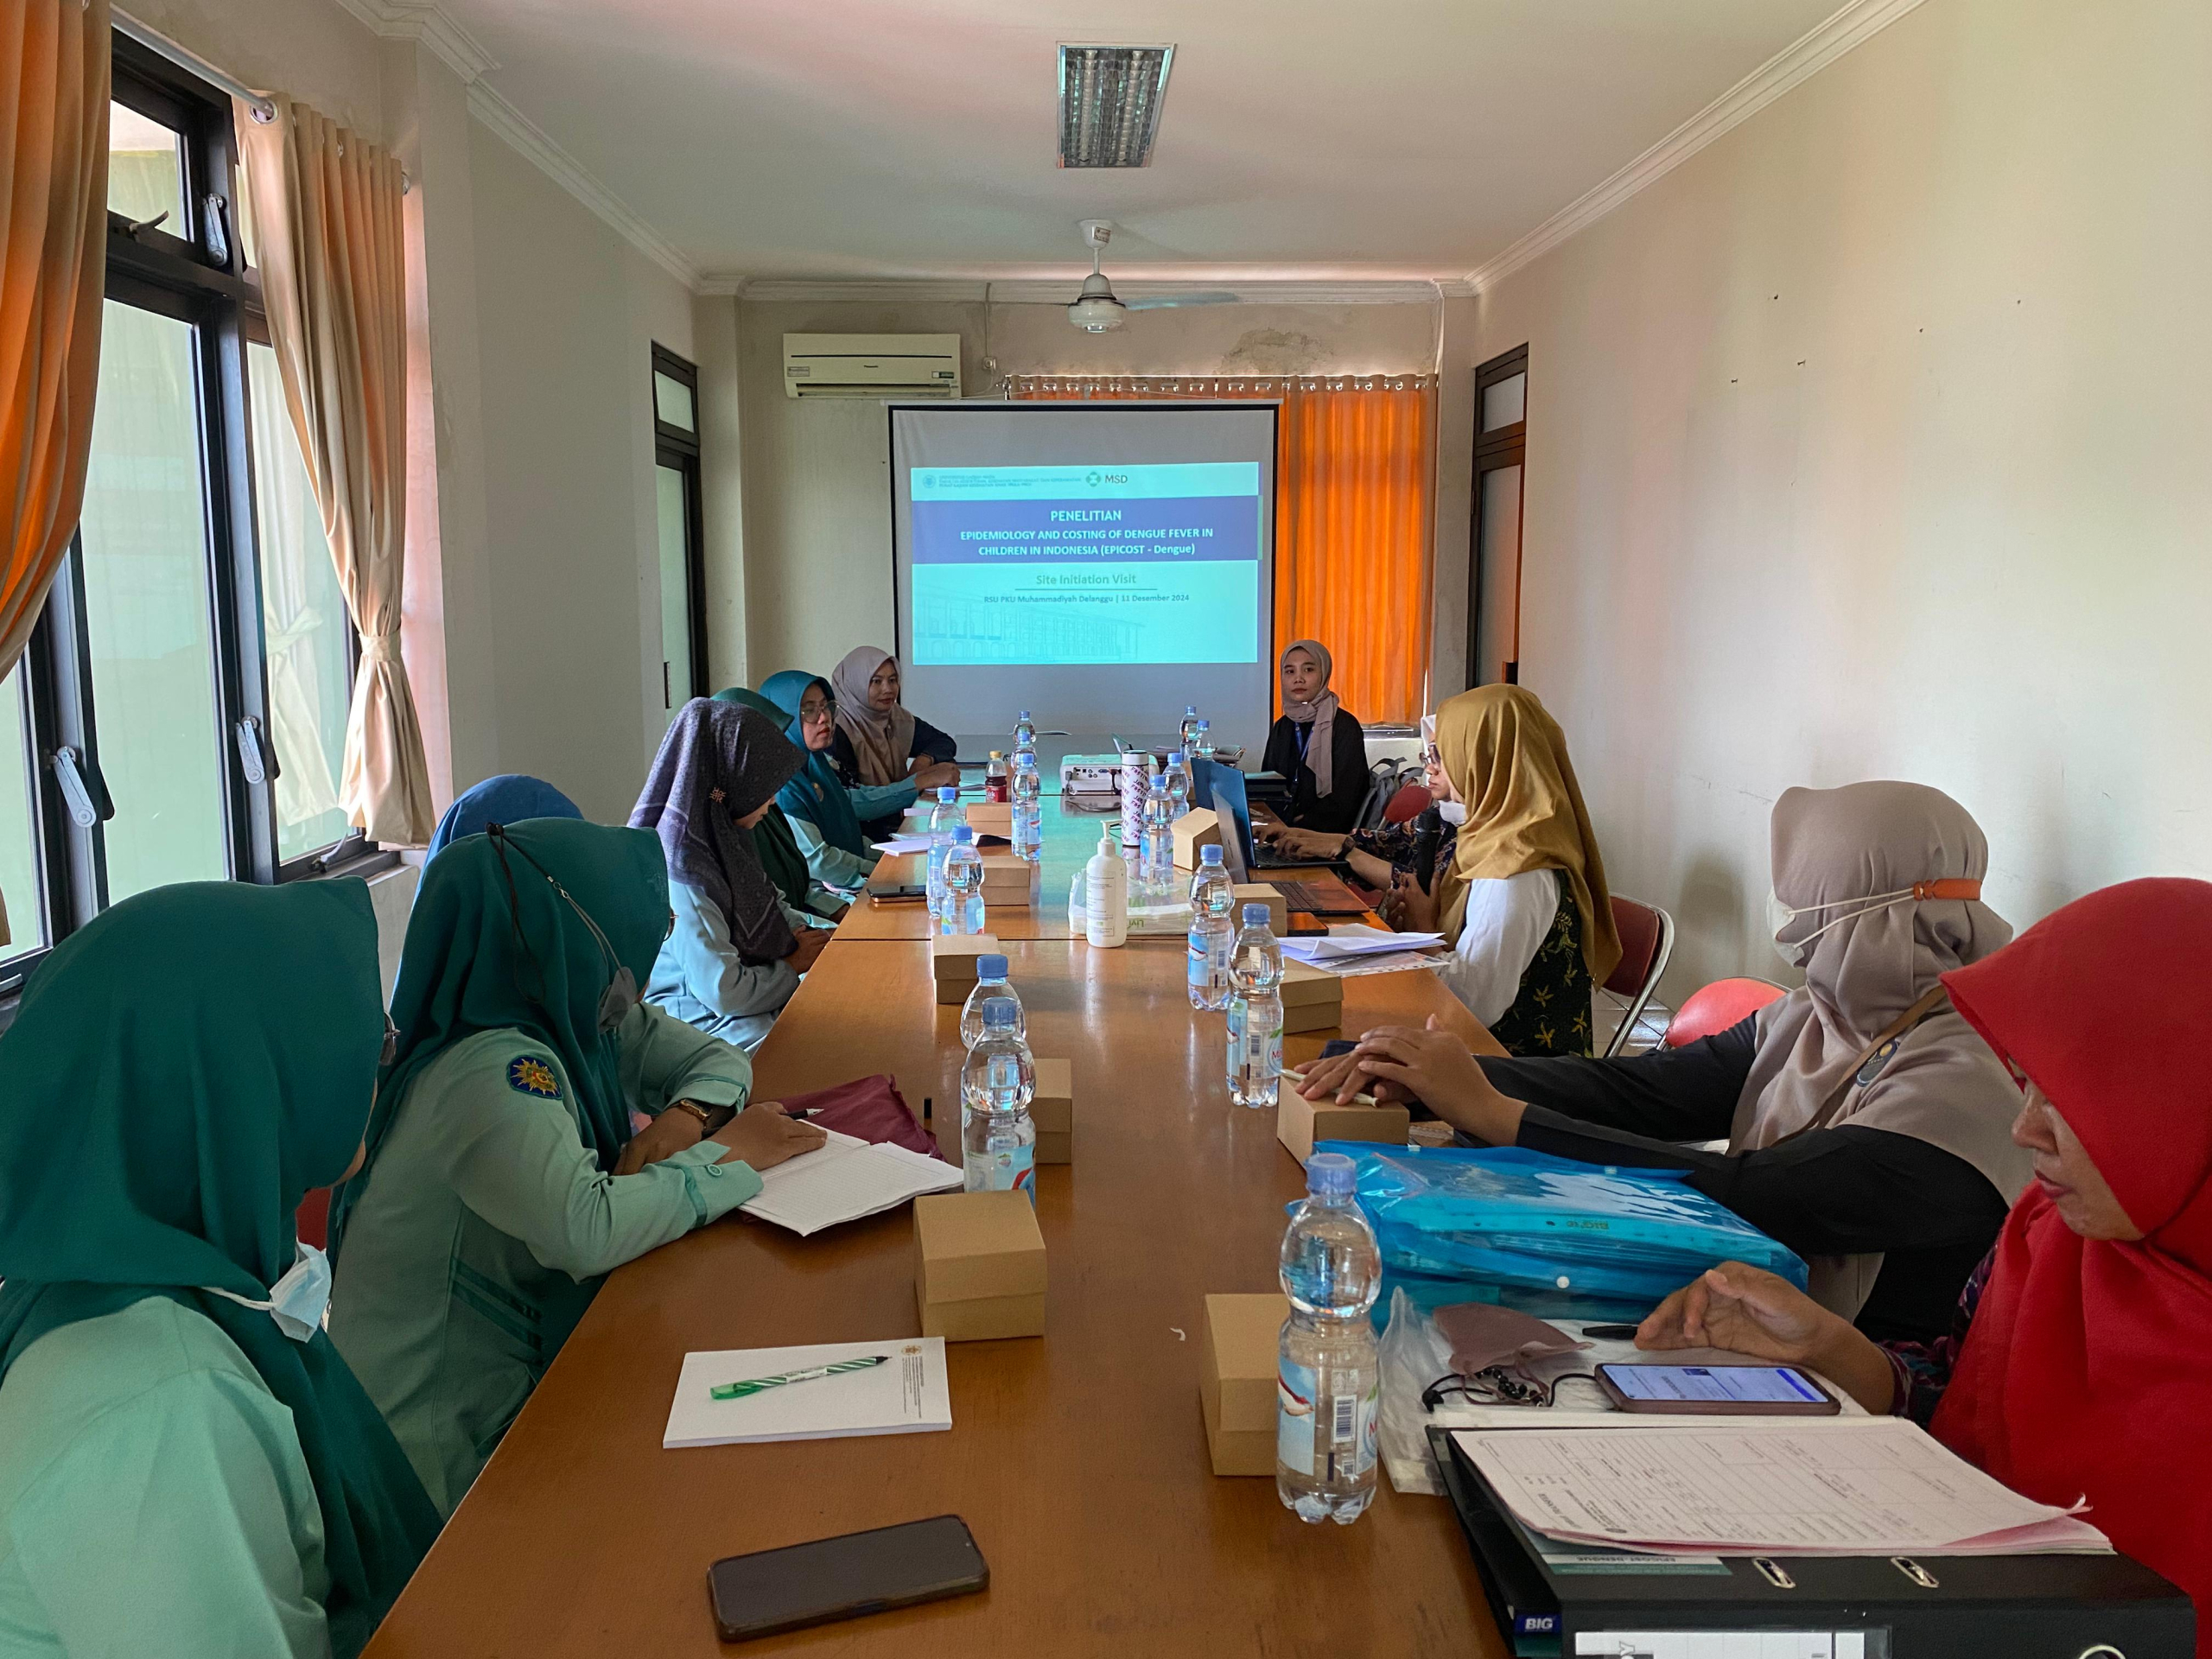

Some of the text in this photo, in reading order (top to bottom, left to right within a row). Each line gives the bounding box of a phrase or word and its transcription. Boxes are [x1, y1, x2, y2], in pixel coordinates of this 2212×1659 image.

[1104, 474, 1128, 484] MSD
[1050, 510, 1122, 522] PENELITIAN
[960, 528, 1214, 541] EPIDEMIOLOGY AND COSTING OF DENGUE FEVER IN
[978, 546, 1027, 556] CHILDREN
[1029, 546, 1041, 555] IN
[1043, 545, 1098, 556] INDONESIA
[1100, 544, 1145, 556] (EPICOST
[1154, 543, 1196, 556] Dengue)
[1036, 574, 1137, 585] Site Initiation Visit
[1018, 594, 1077, 604] Muhammadiyah
[1079, 594, 1114, 604] Delanggu
[1132, 594, 1170, 602] Desember
[1524, 1618, 1554, 1630] BIG
